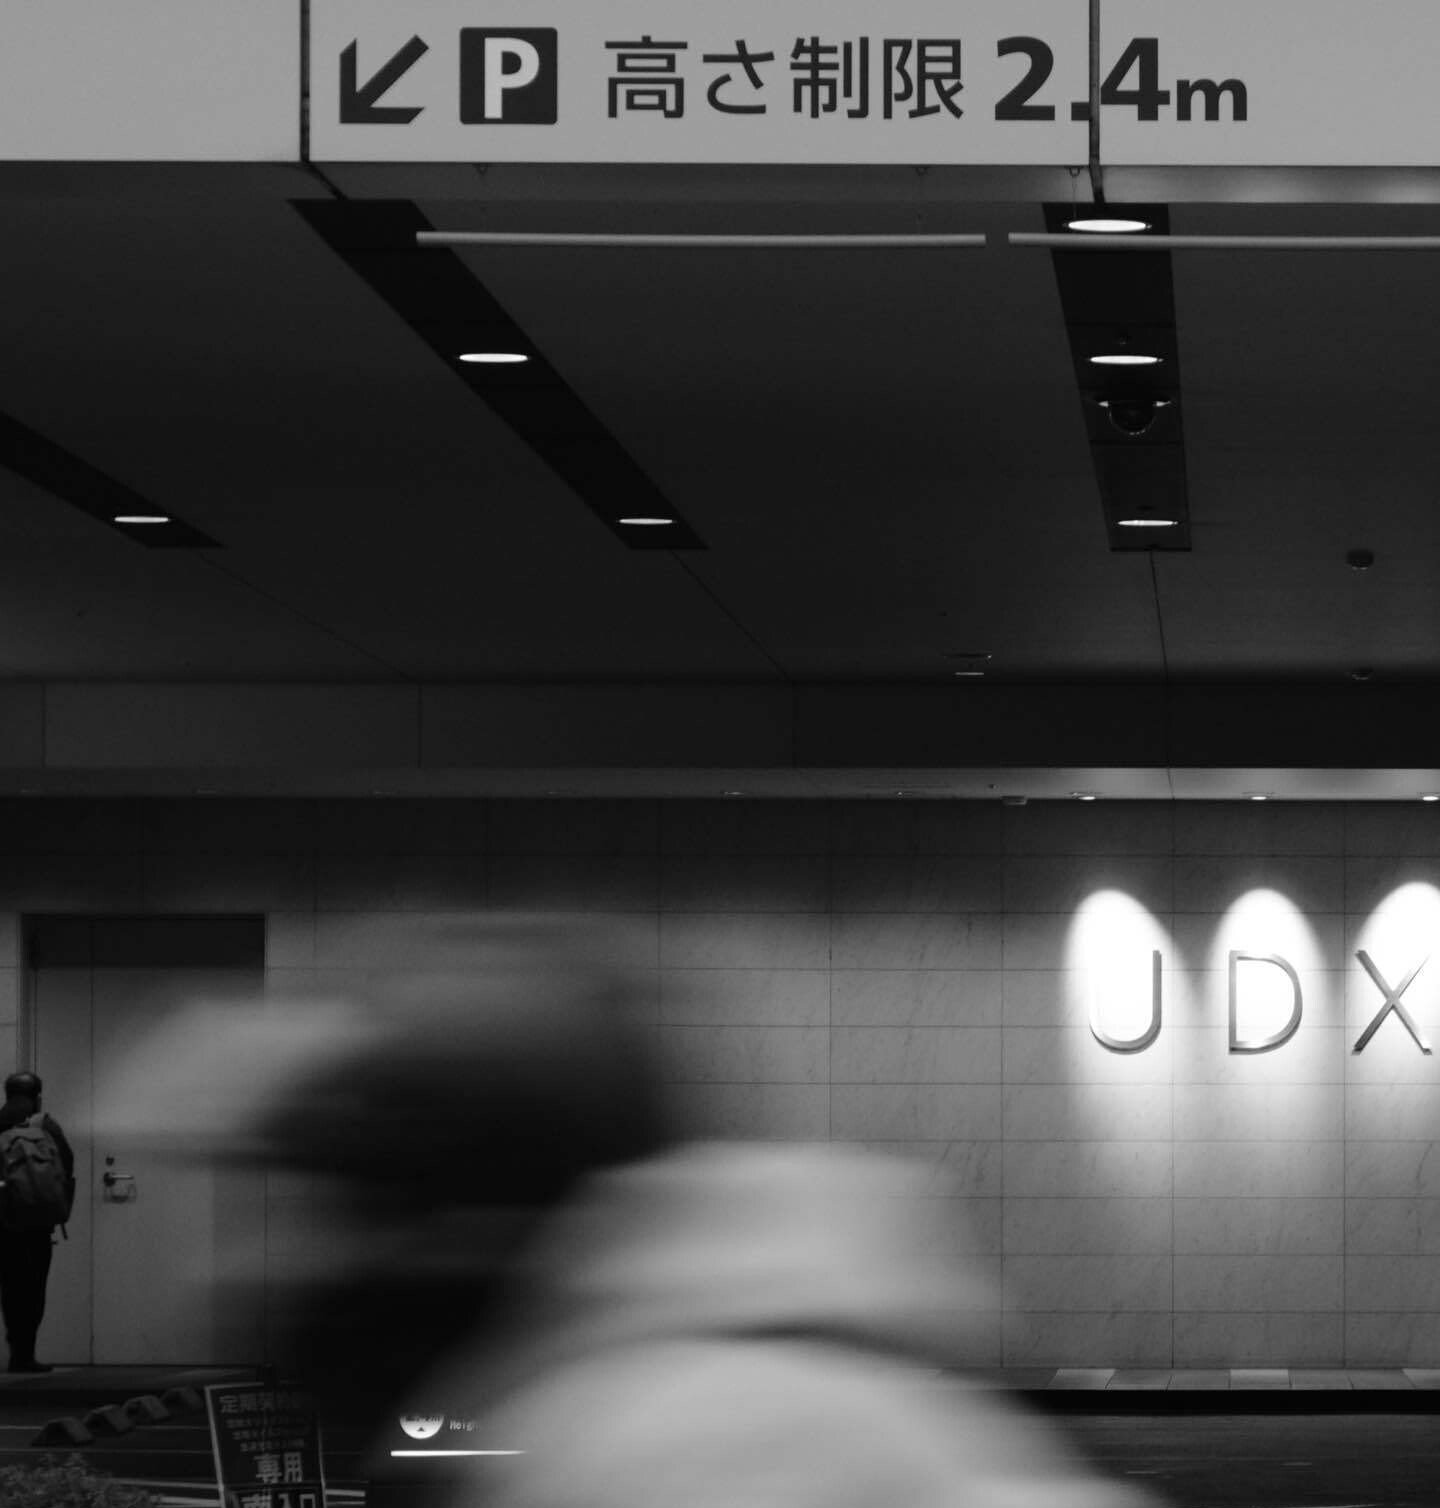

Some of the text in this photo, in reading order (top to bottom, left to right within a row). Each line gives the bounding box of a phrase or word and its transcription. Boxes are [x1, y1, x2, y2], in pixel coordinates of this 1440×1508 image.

[482, 35, 1249, 122] P 高さ制限 2.4m
[254, 1451, 304, 1484] 専用
